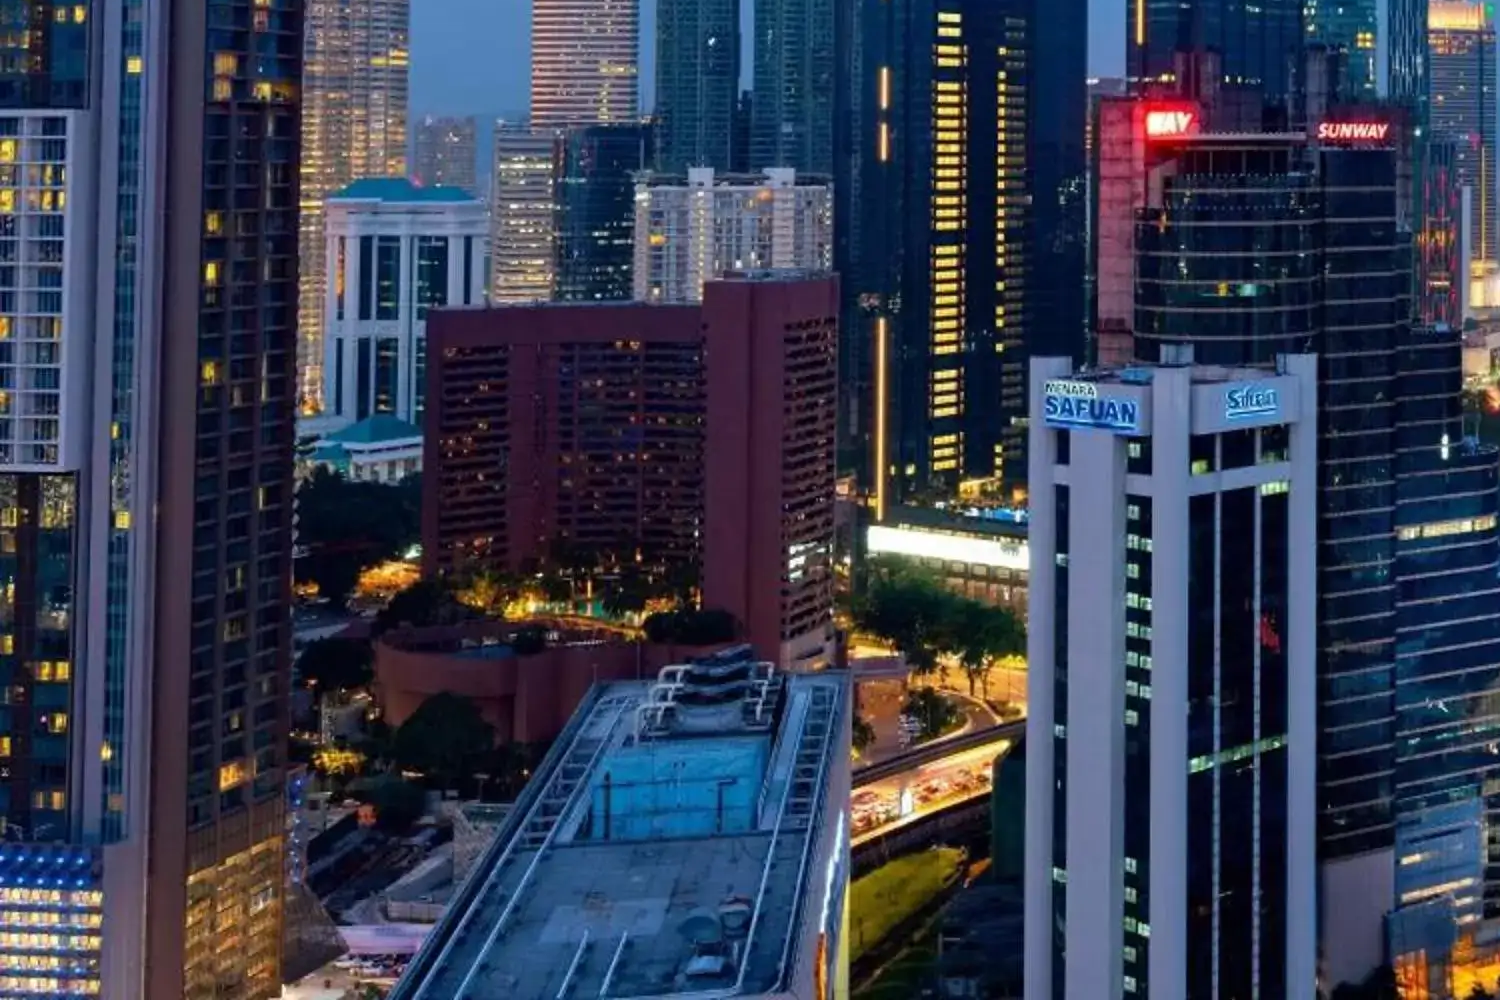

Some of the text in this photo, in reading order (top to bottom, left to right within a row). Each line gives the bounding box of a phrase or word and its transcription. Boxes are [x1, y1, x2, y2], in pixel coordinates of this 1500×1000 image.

[1317, 122, 1389, 139] SUNWAY
[1045, 382, 1096, 397] MENARA
[1045, 396, 1136, 424] SAFUAN
